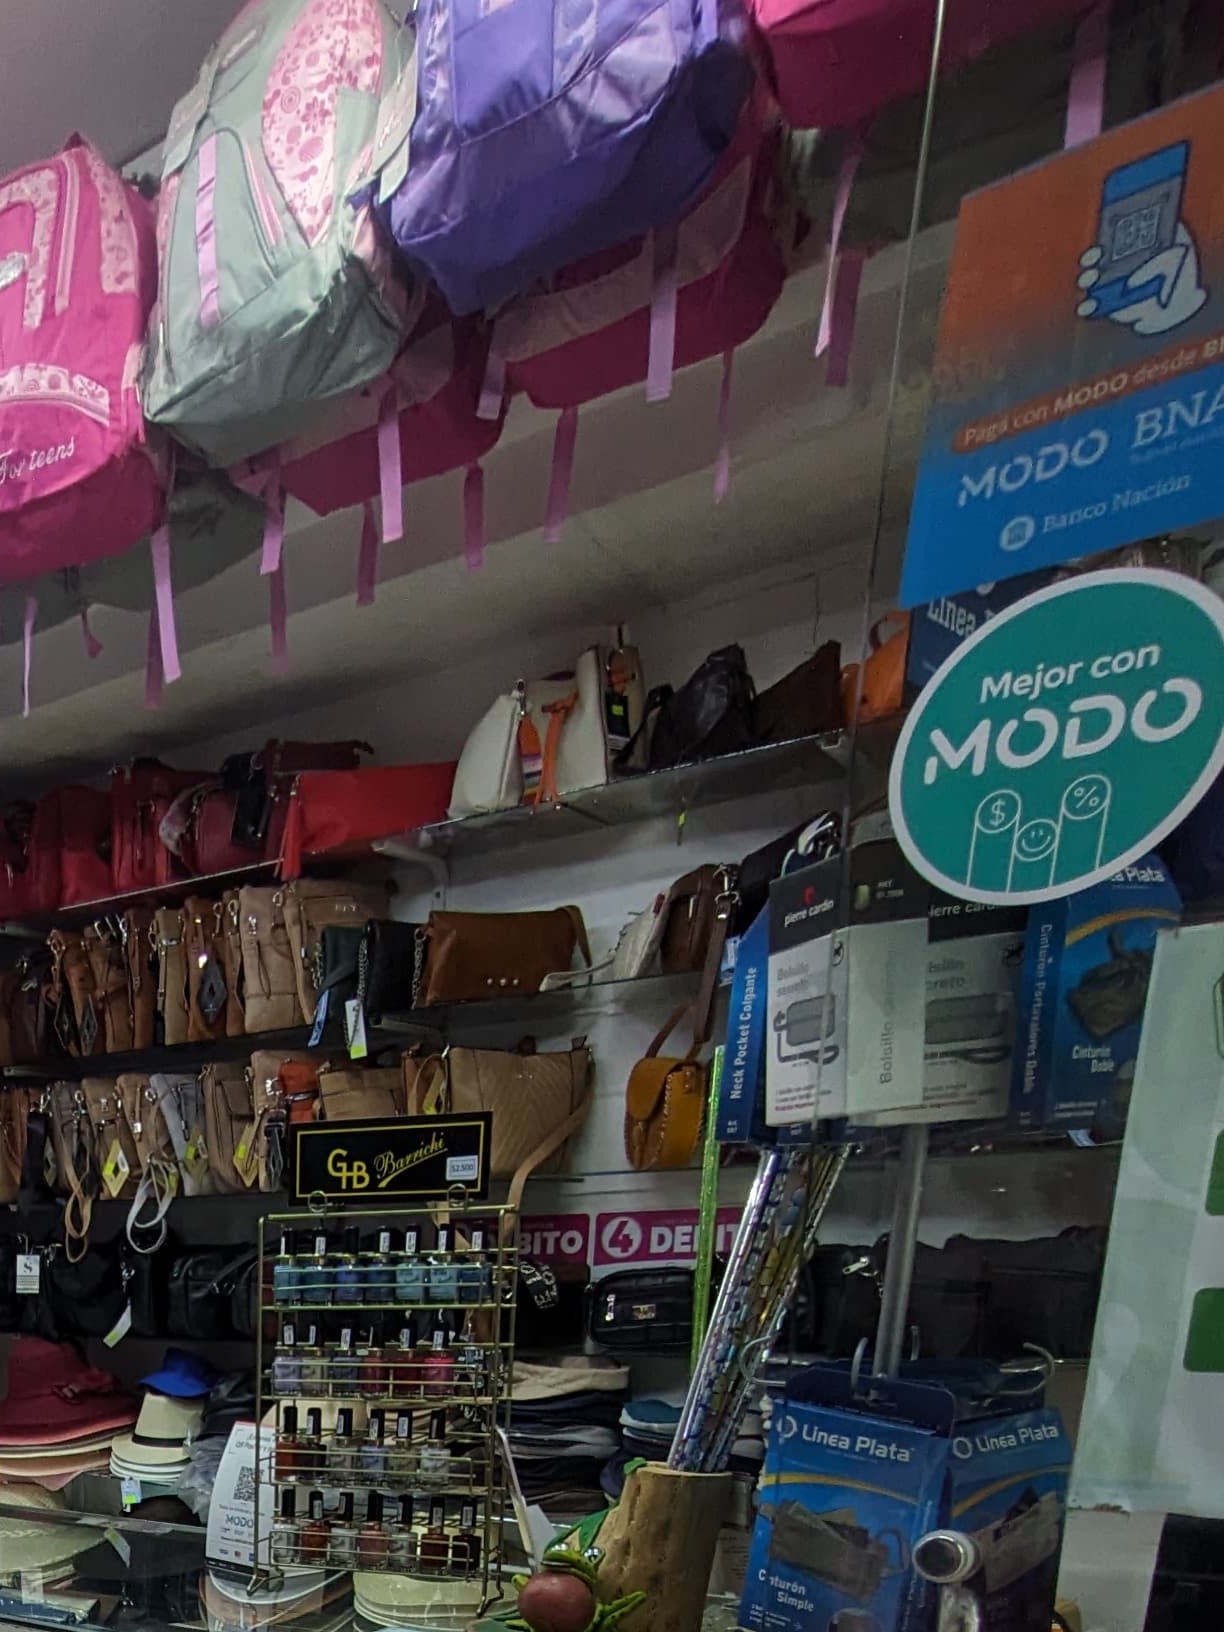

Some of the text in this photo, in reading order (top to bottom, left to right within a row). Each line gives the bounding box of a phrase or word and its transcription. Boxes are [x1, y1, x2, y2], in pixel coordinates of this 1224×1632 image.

[1013, 406, 1048, 428] con
[1054, 373, 1127, 414] MODO
[28, 435, 75, 471] teens
[957, 428, 1109, 508] MODO
[1042, 474, 1192, 534] Banco Nación
[980, 643, 1162, 703] Mejor con
[923, 676, 1203, 785] MODO
[1125, 866, 1165, 882] Plata
[784, 899, 834, 928] pierre cardin
[739, 967, 758, 1022] Colgante
[734, 1022, 751, 1066] Pocket
[729, 1066, 745, 1100] Neck
[802, 1422, 911, 1463] Linea Plata
[976, 1424, 1059, 1453] Linea Plata
[225, 1514, 254, 1529] MODO
[776, 1591, 815, 1613] Simple
